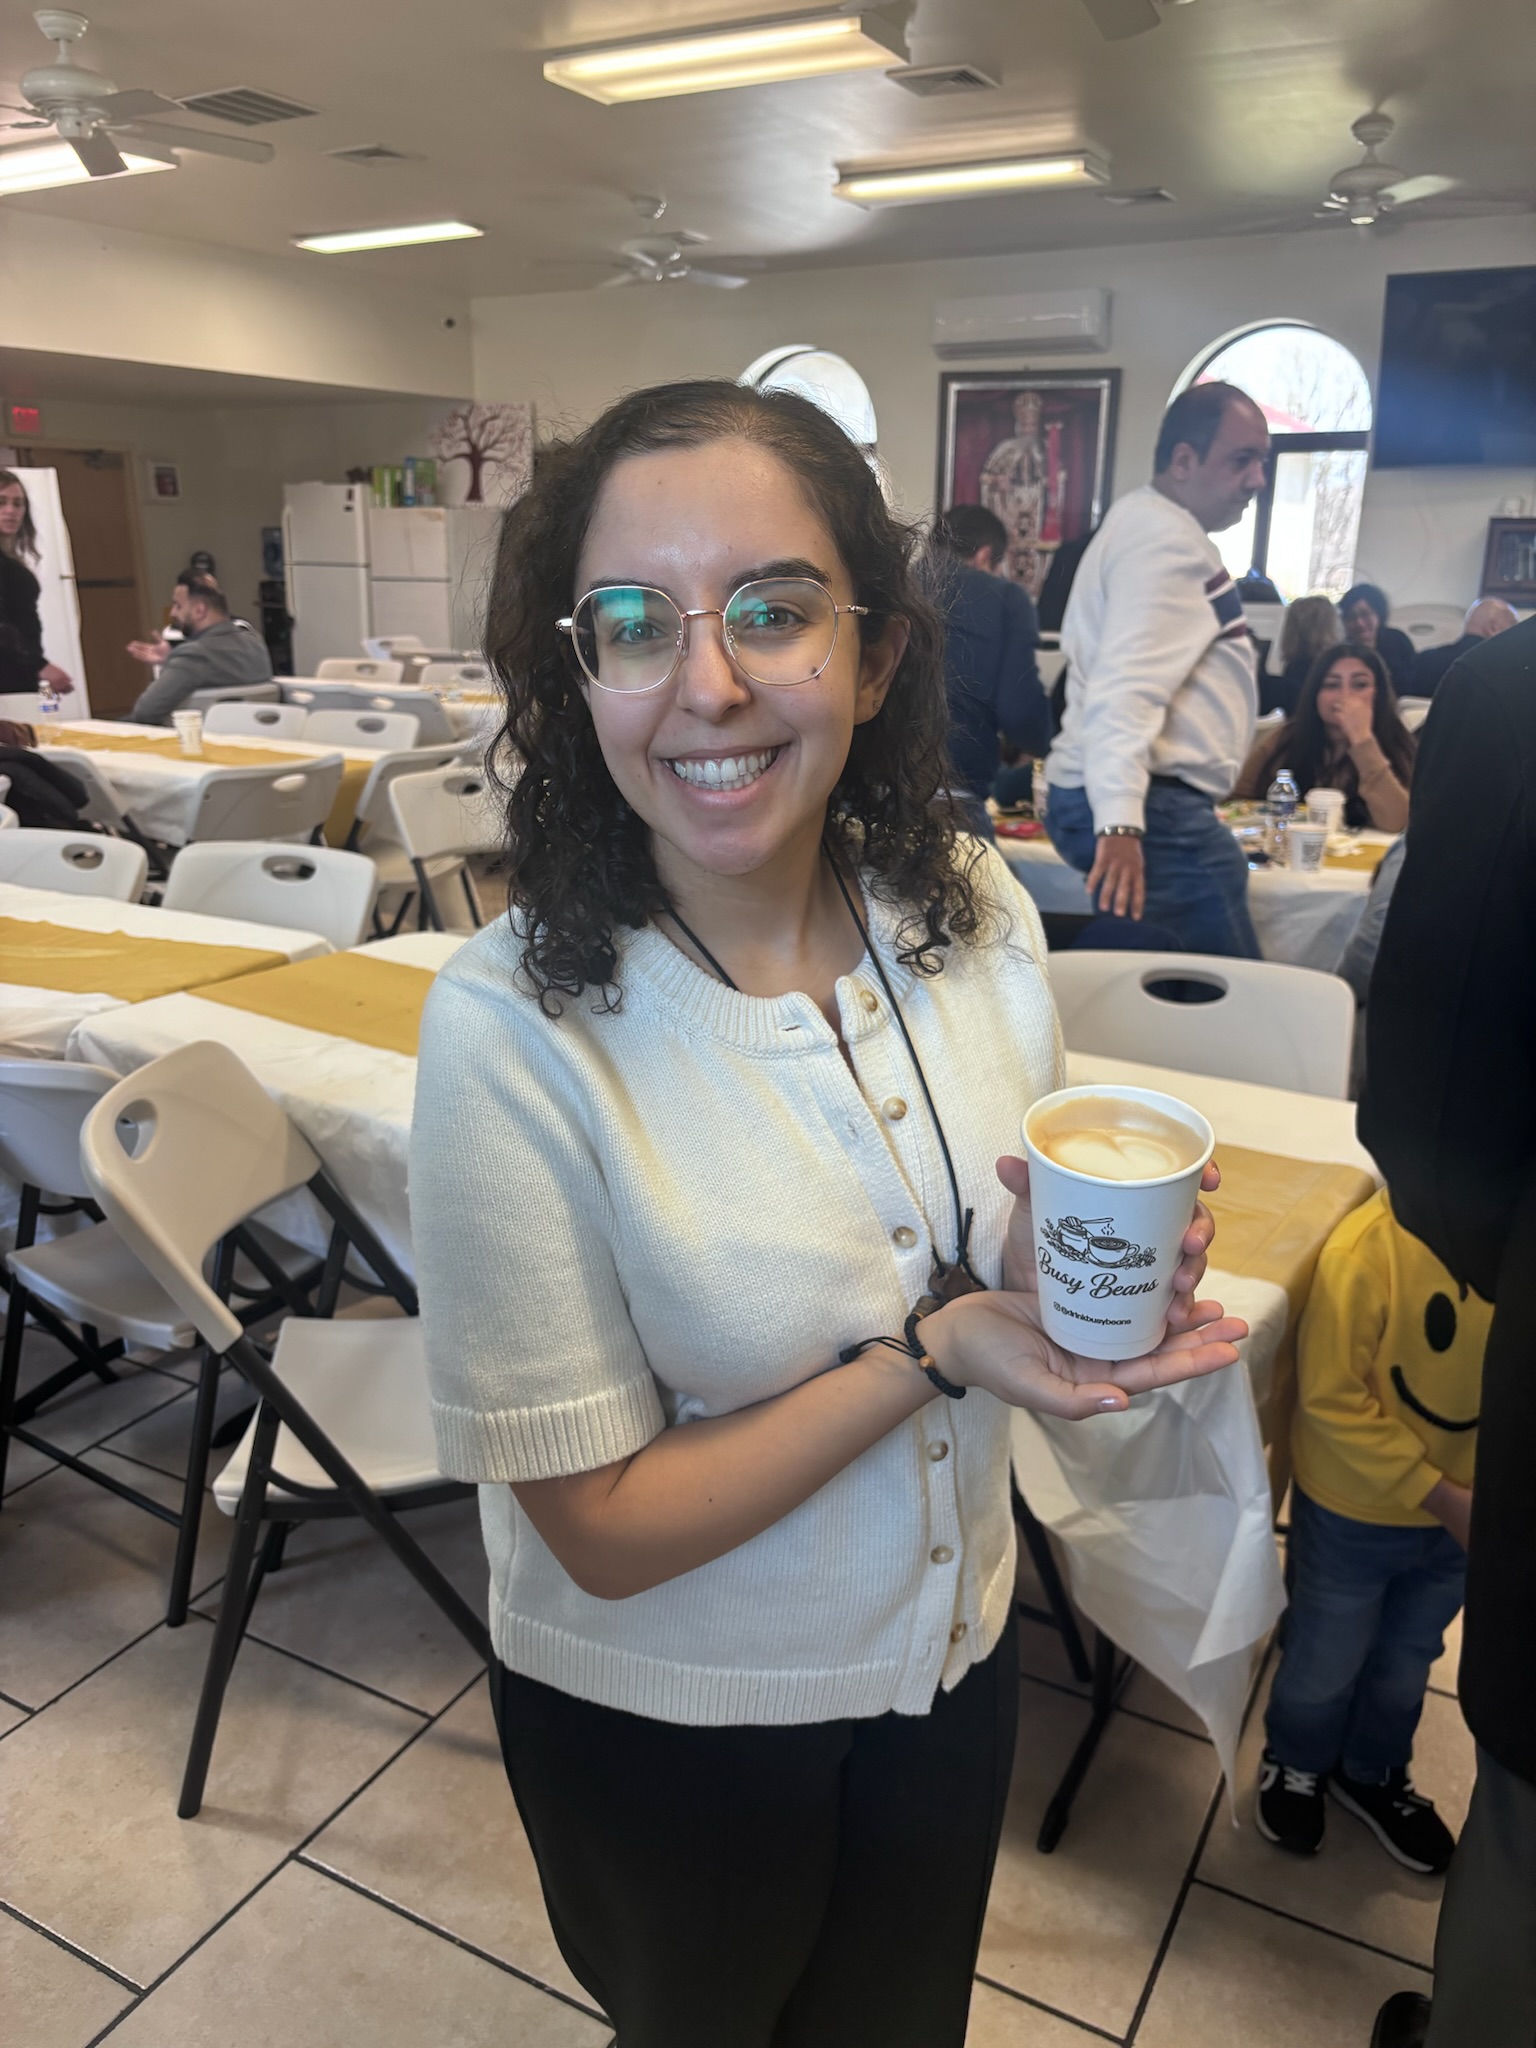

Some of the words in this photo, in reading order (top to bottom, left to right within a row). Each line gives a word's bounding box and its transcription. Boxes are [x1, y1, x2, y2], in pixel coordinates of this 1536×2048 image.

[1038, 1246, 1085, 1294] Busy
[1089, 1273, 1159, 1299] Beans
[1061, 1306, 1131, 1325] @drinkbusybeans
